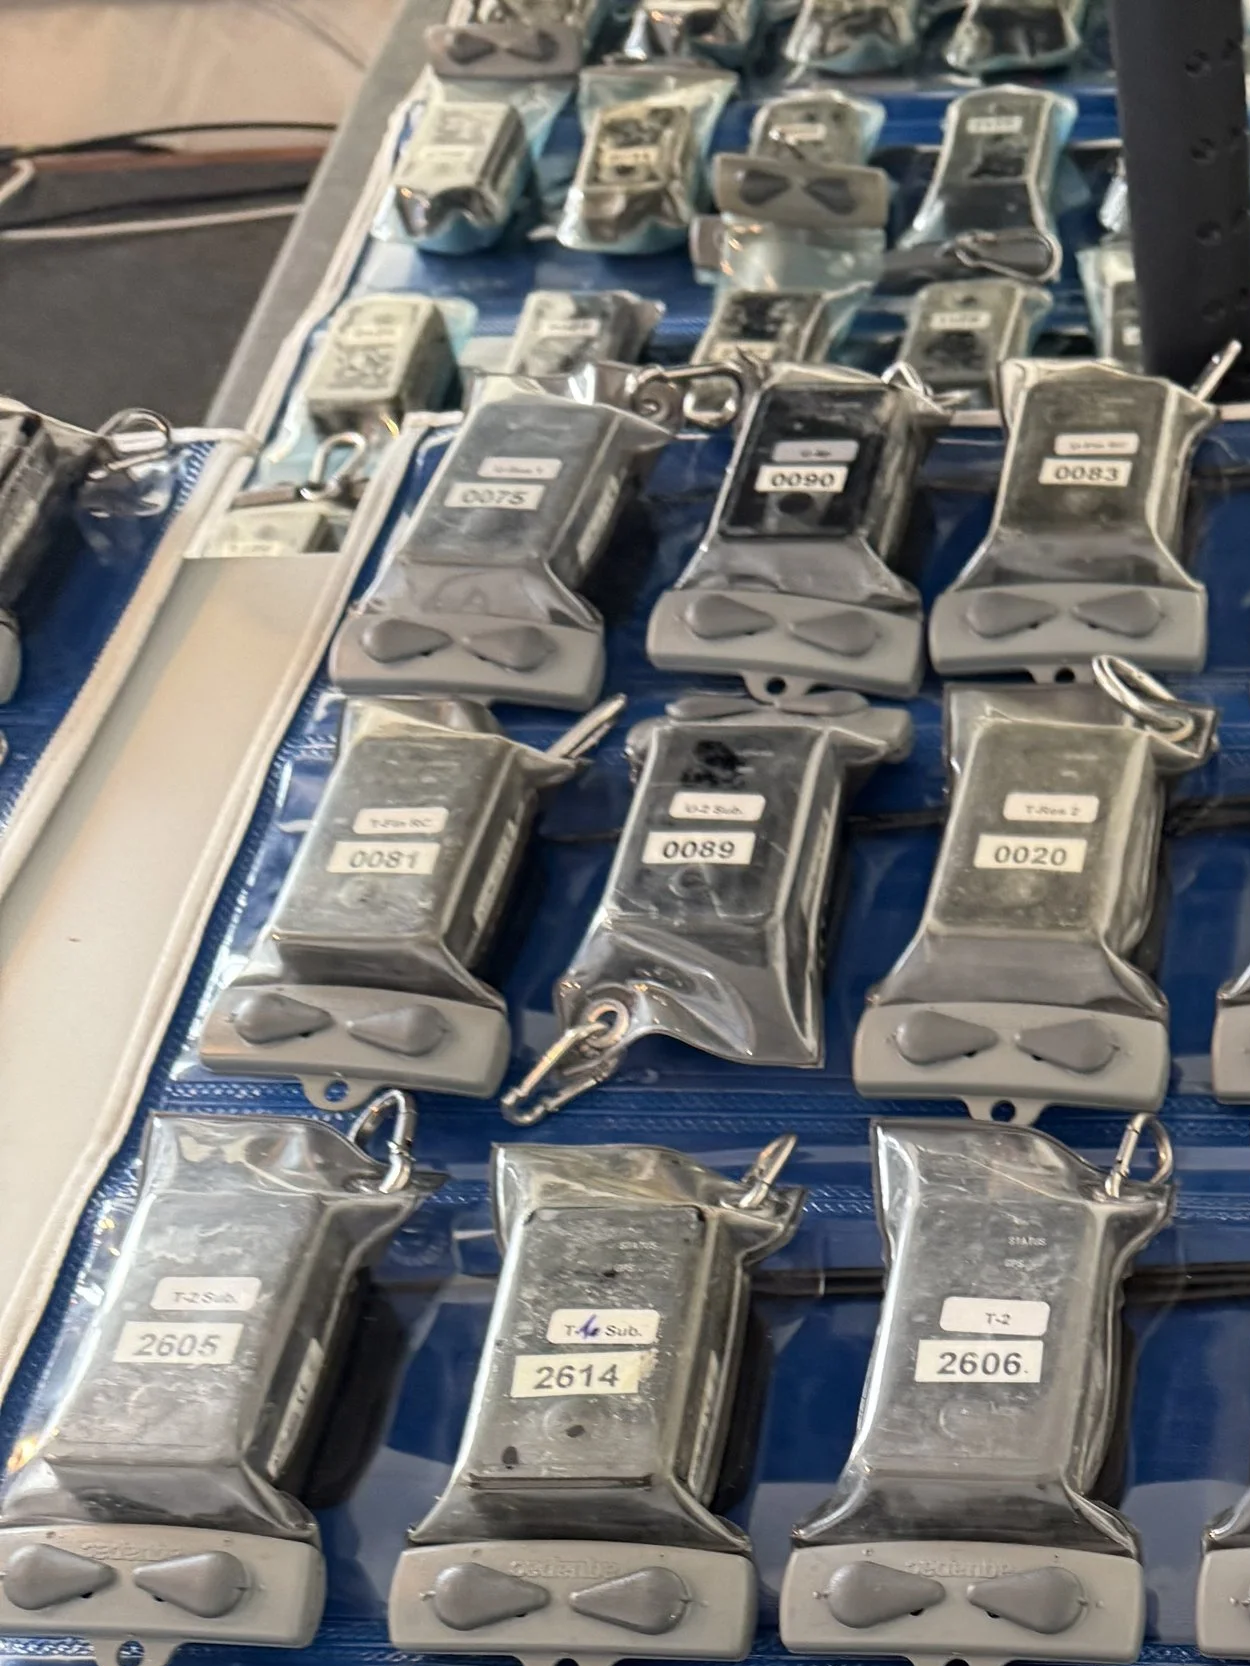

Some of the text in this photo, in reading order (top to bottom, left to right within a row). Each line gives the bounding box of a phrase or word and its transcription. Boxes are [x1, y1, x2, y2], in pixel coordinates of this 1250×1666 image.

[771, 472, 835, 488] 0090
[1054, 465, 1119, 482] 0083
[461, 488, 530, 506] 0075
[663, 840, 735, 859] 0089
[994, 845, 1067, 867] 0020
[349, 849, 421, 870] 0081
[985, 1311, 1012, 1326] T-2
[604, 1325, 642, 1337] Sub.
[132, 1333, 221, 1357] 2605
[937, 1351, 1022, 1376] 2606
[533, 1363, 620, 1390] 2614
